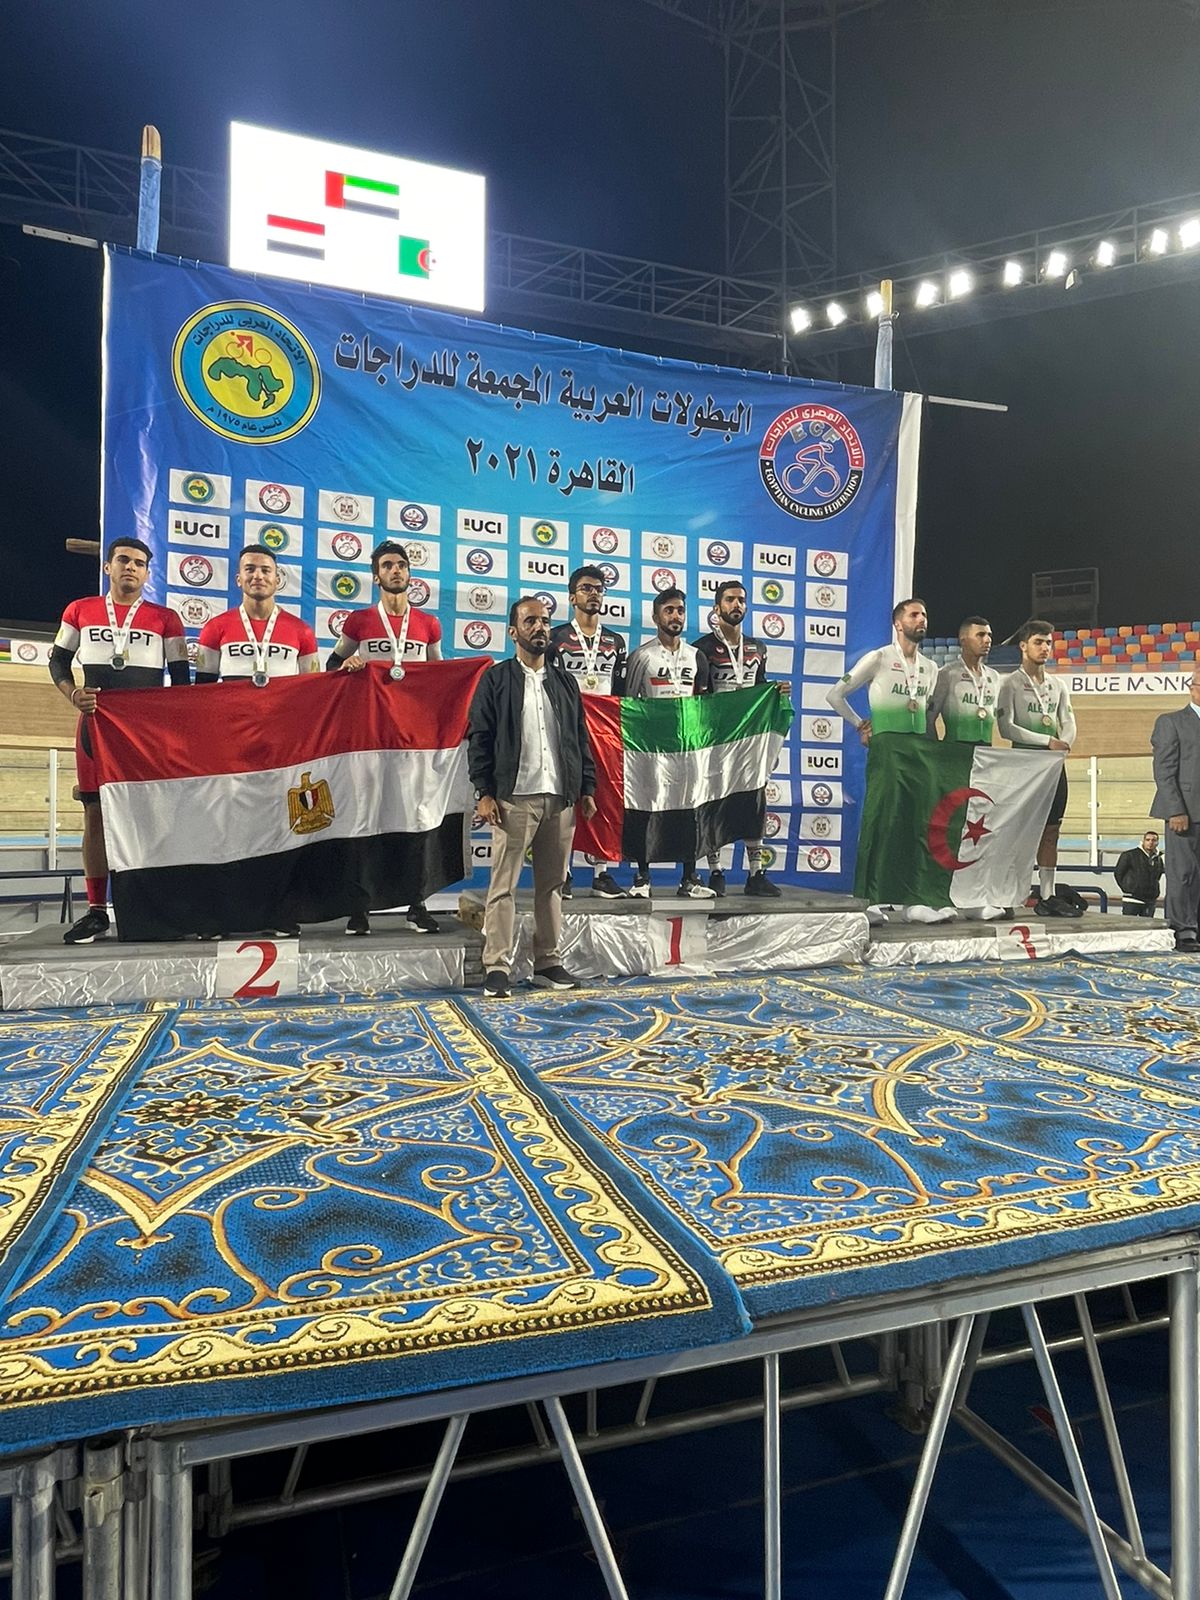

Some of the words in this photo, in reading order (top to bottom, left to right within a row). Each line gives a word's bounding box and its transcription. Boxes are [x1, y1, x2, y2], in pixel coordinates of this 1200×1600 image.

[334, 332, 460, 391] للدراجات
[465, 351, 551, 410] المجمعة
[559, 368, 643, 423] العربية
[651, 390, 752, 443] البطولات
[789, 420, 841, 444] ECF
[466, 437, 538, 484] ٢٠٢١
[547, 449, 635, 496] القاهرة
[764, 468, 791, 507] EGYPTIAN
[789, 502, 824, 517] CYCLING
[823, 473, 859, 515] FEDERATION
[183, 521, 220, 539] UCI
[471, 519, 502, 535] UCI
[534, 561, 564, 576] UCI
[766, 553, 791, 567] UCI
[600, 604, 625, 618] UCI
[89, 628, 153, 646] EGPT
[816, 624, 840, 637] UCI
[367, 640, 424, 655] EGPT
[657, 667, 692, 677] UE
[1072, 677, 1120, 692] BLUE
[813, 757, 839, 768] UCI
[665, 916, 685, 965] 1
[233, 941, 280, 997] 2
